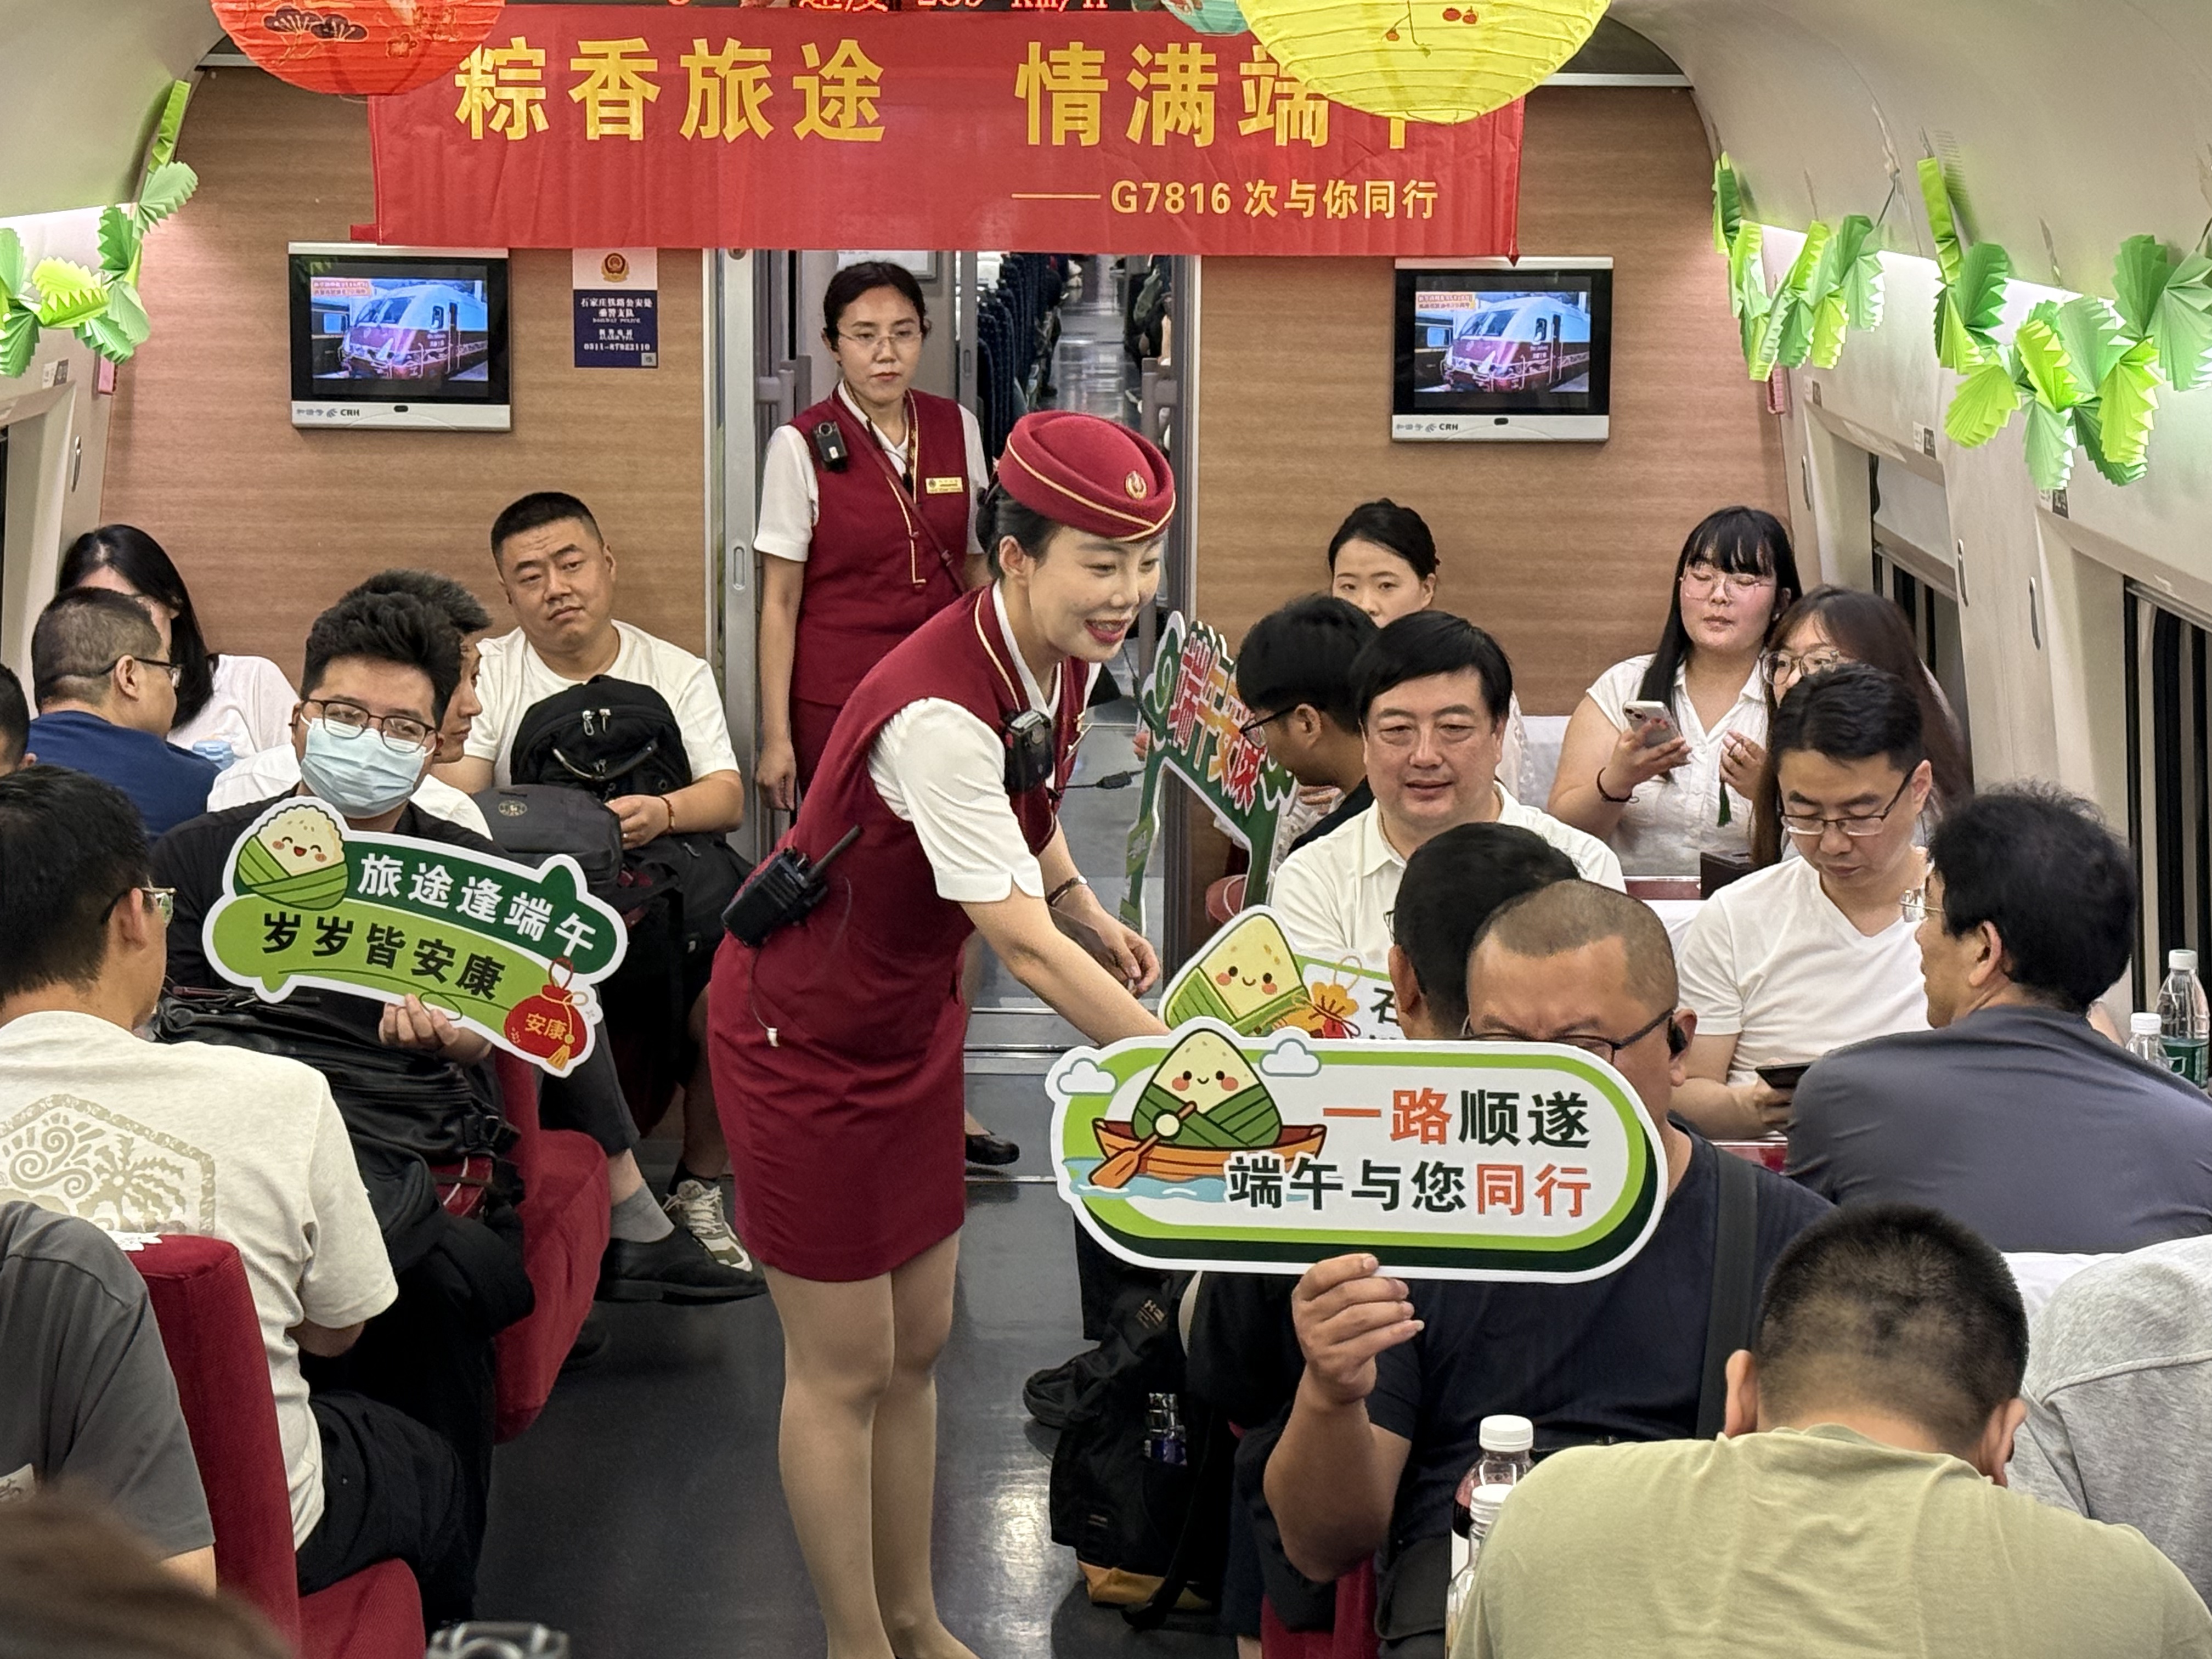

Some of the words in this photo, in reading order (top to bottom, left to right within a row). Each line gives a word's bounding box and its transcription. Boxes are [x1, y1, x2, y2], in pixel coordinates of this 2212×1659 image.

[454, 36, 885, 142] 粽香旅途
[1014, 41, 1411, 150] 情满端
[1243, 179, 1439, 219] 次与你同行
[358, 852, 597, 958] 旅途逢端午
[261, 911, 506, 1001] 岁岁皆安康
[525, 1012, 566, 1041] 安康
[1323, 1088, 1590, 1148] 一路顺遂
[1228, 1155, 1591, 1217] 端午与您同行
